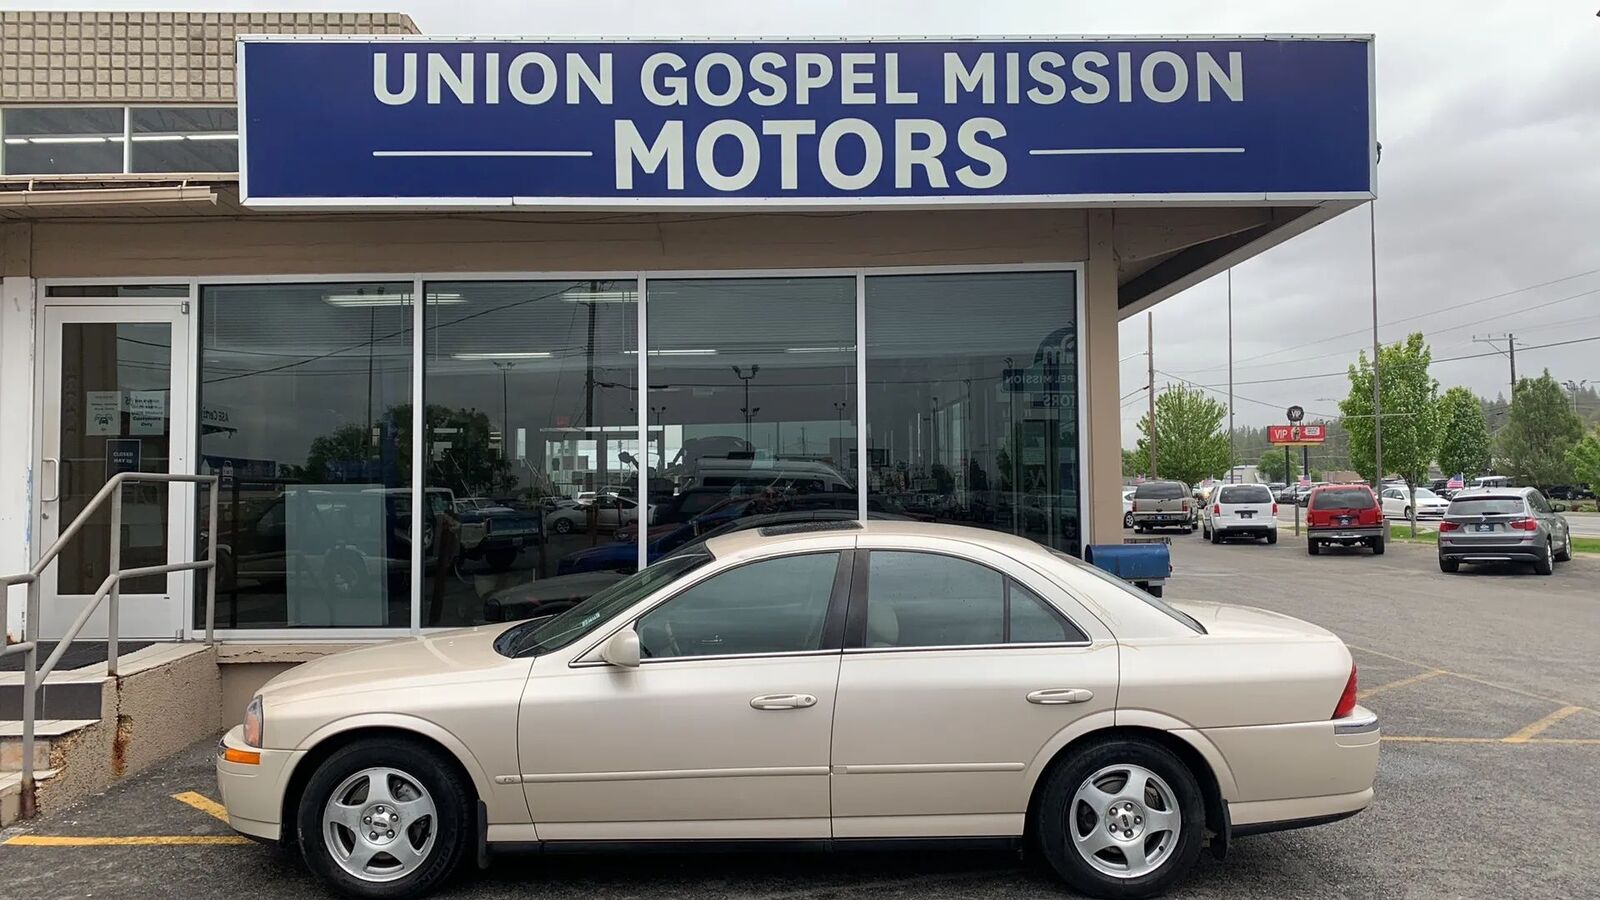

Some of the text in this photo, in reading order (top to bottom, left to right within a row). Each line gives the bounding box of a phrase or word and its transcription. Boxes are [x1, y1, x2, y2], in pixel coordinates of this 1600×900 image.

[373, 50, 1245, 107] UNION GOSPEL MISSION
[614, 116, 1009, 192] MOTORS
[1291, 410, 1301, 418] VIP
[1274, 429, 1288, 439] VIP
